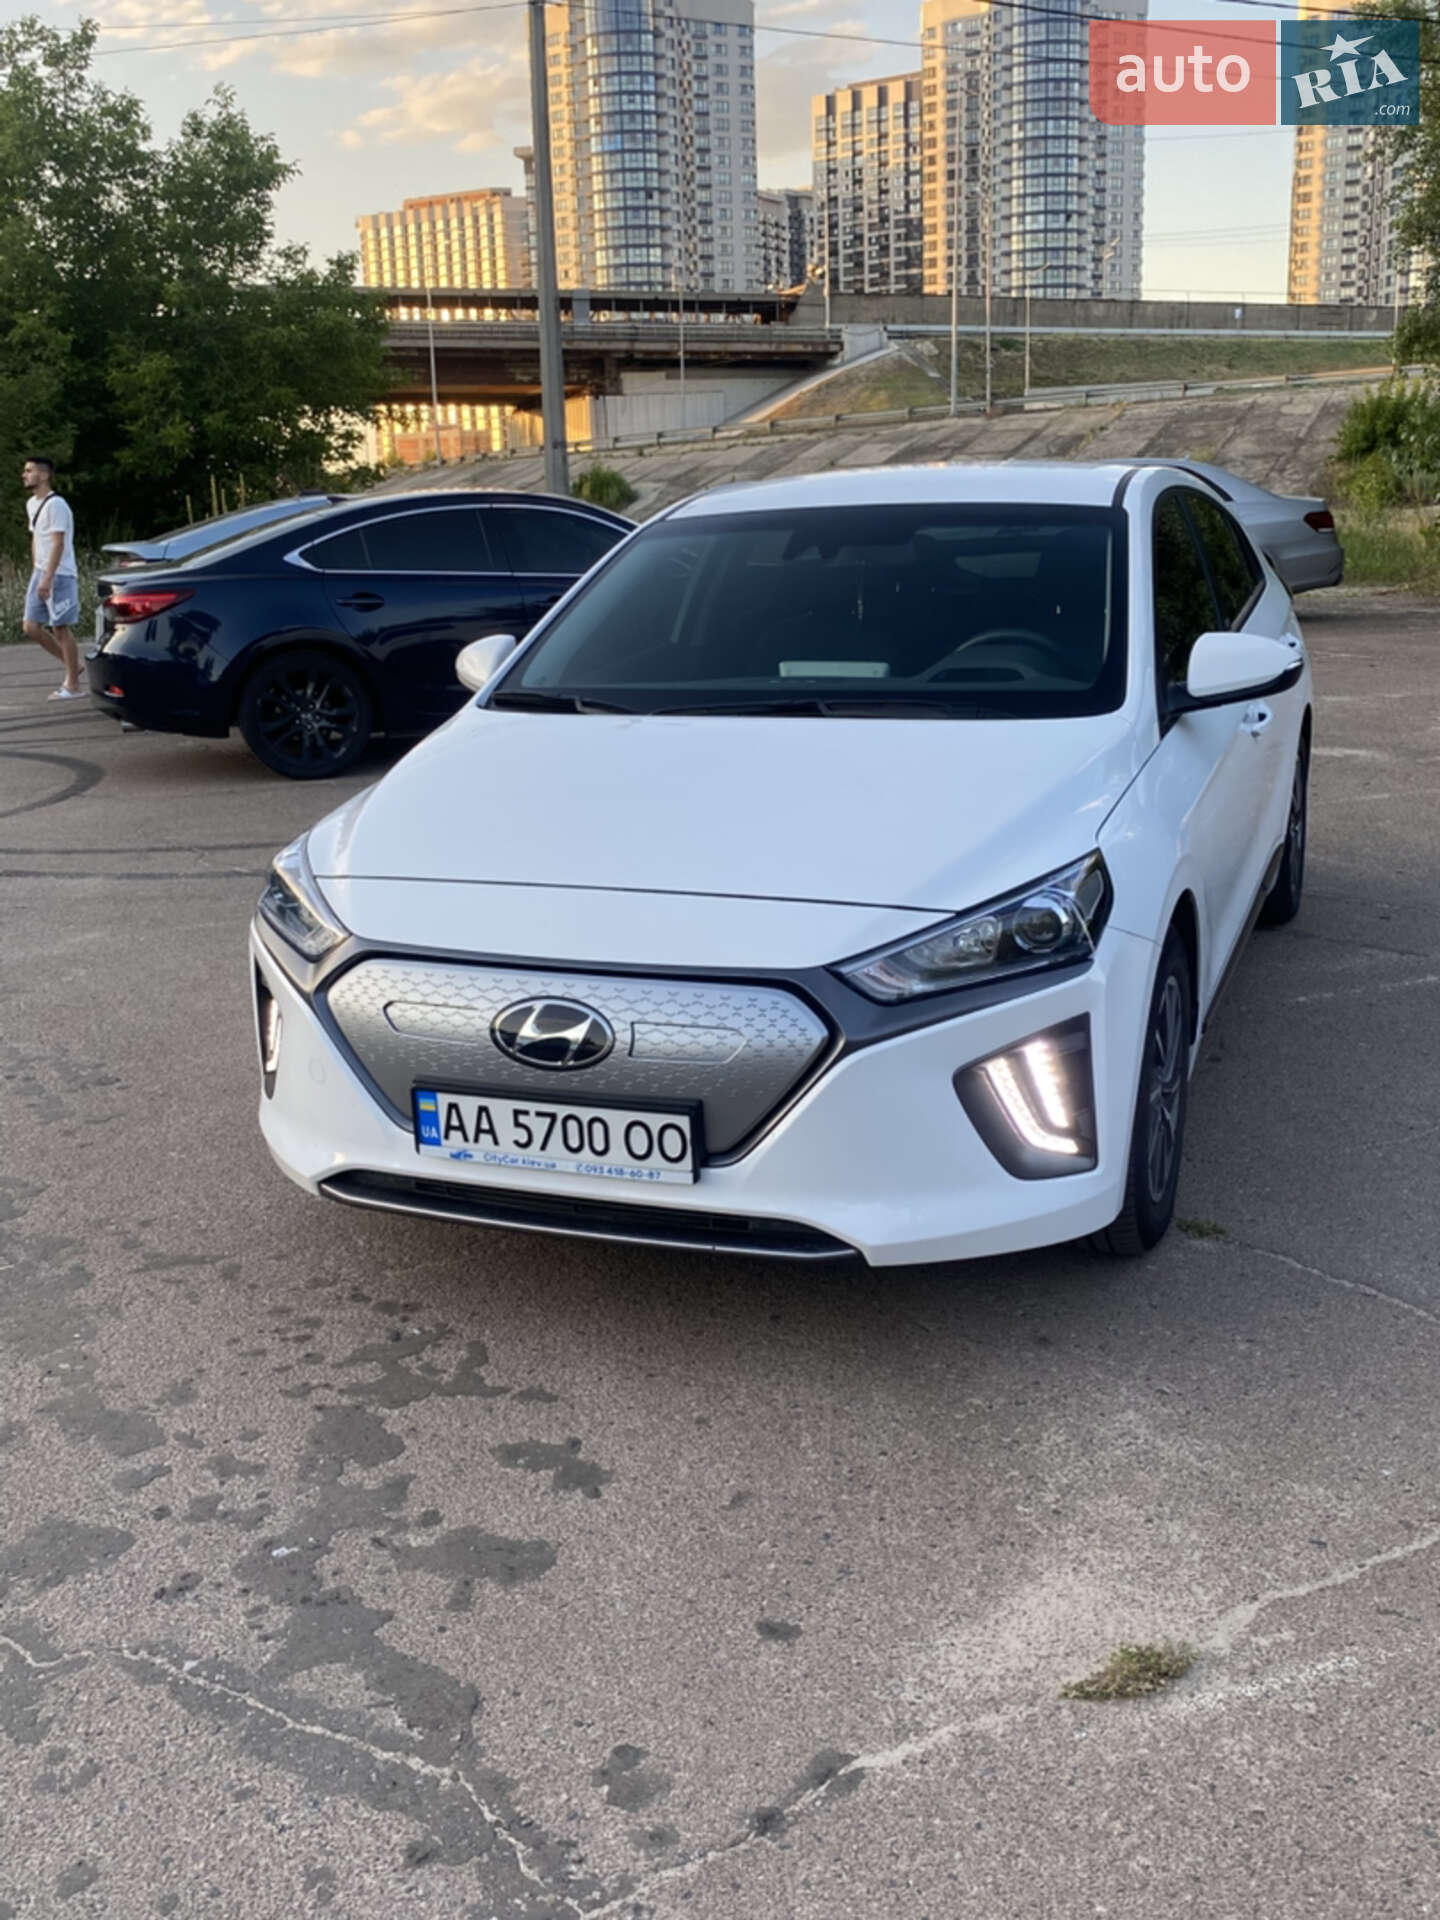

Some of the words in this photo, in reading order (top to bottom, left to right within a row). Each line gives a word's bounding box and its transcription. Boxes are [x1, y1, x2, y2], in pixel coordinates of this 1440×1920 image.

[421, 1125, 439, 1139] UA
[443, 1101, 500, 1147] AA
[512, 1108, 610, 1157] 5700
[623, 1119, 688, 1164] OO
